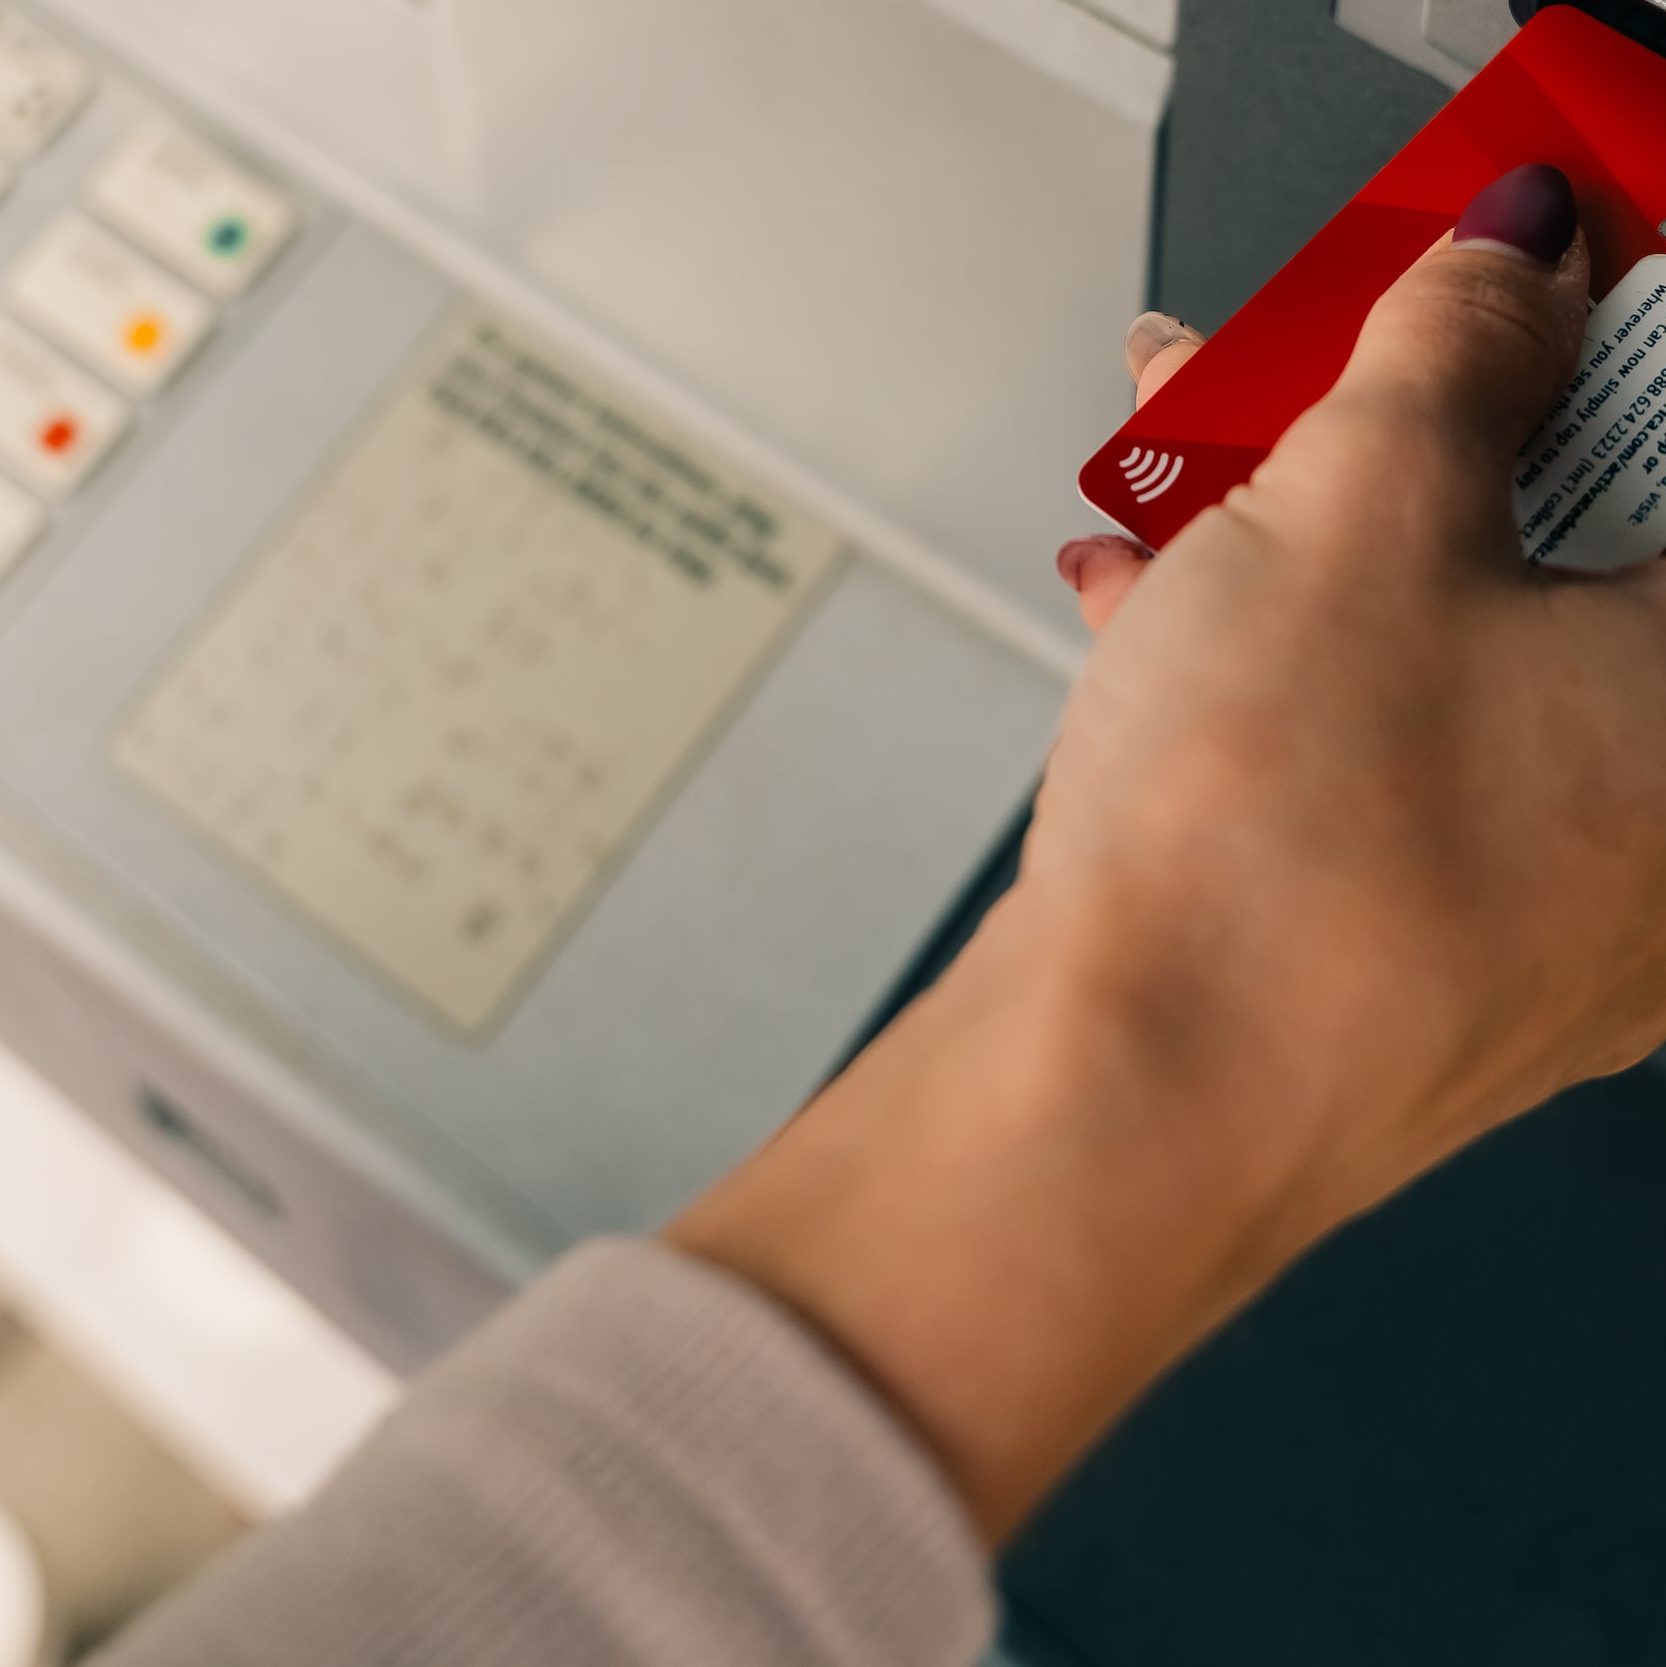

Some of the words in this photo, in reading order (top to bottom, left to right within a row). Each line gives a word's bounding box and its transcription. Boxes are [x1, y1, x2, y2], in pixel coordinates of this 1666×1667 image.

[1643, 324, 1666, 348] can
[1589, 340, 1615, 368] you
[1618, 348, 1647, 378] now
[1567, 368, 1591, 393] see
[1576, 378, 1619, 422] simply
[1555, 423, 1581, 446] tap
[1541, 447, 1559, 464] to
[1642, 456, 1659, 474] or
[1515, 462, 1543, 492] pay
